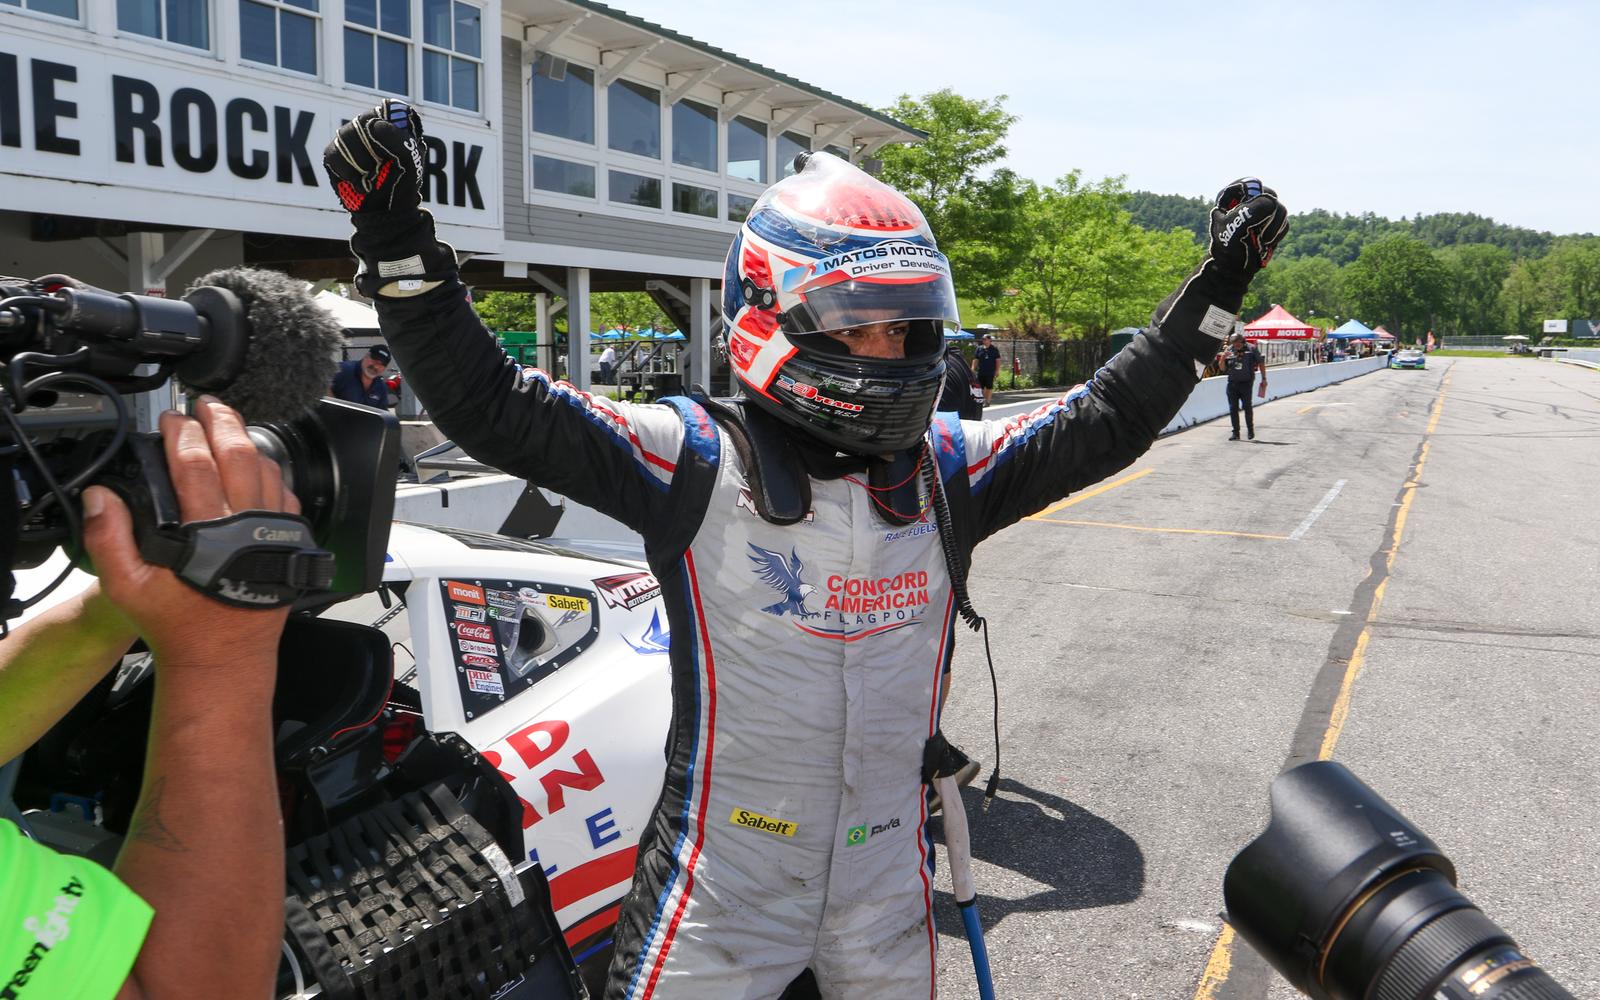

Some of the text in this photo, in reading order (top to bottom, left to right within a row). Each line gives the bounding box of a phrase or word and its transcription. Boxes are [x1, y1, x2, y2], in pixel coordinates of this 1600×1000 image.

[113, 75, 319, 187] ROCK
[1218, 206, 1252, 247] Sabelt
[823, 247, 888, 271] MATOS
[852, 262, 895, 275] Driver
[253, 526, 302, 542] Canon
[908, 522, 937, 536] FUELS
[827, 570, 928, 596] CONCORD
[453, 587, 480, 599] monit
[550, 596, 585, 611] Sabelt
[825, 590, 929, 614] AMERICAN
[824, 610, 924, 625] FLAGPOL
[469, 642, 496, 654] brembo
[736, 811, 793, 835] Sabelt
